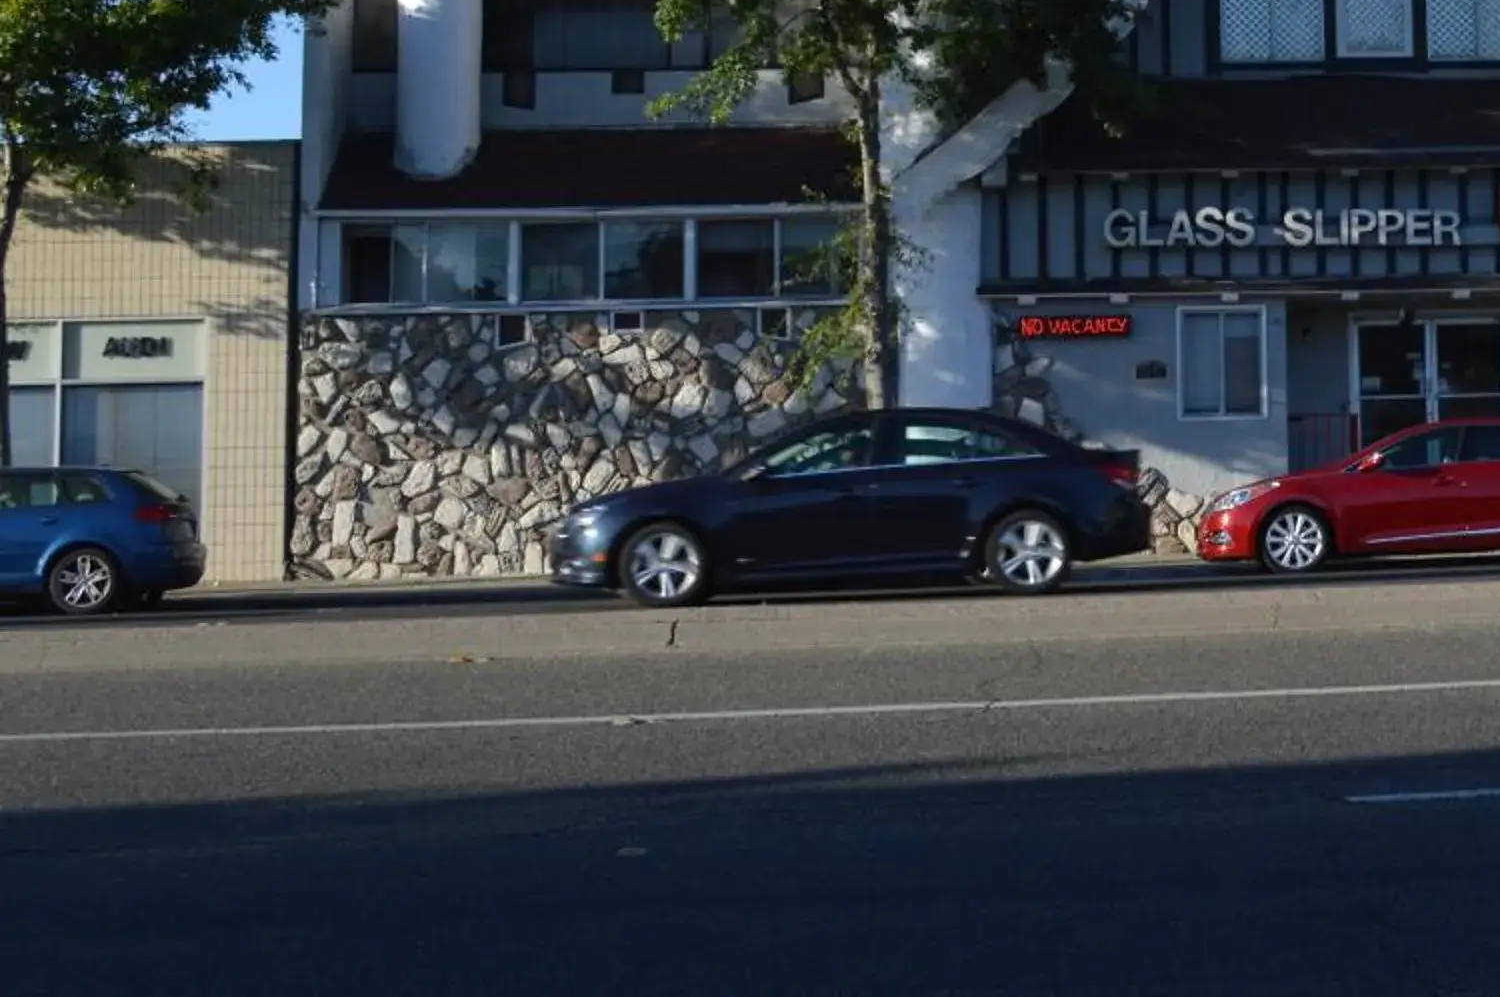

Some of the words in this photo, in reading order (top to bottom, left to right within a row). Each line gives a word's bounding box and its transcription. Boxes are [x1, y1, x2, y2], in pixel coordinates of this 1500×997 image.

[1103, 206, 1256, 247] GLASS
[1282, 207, 1462, 246] SLIPPER
[1021, 317, 1043, 336] NO
[1049, 316, 1128, 334] VACANCY
